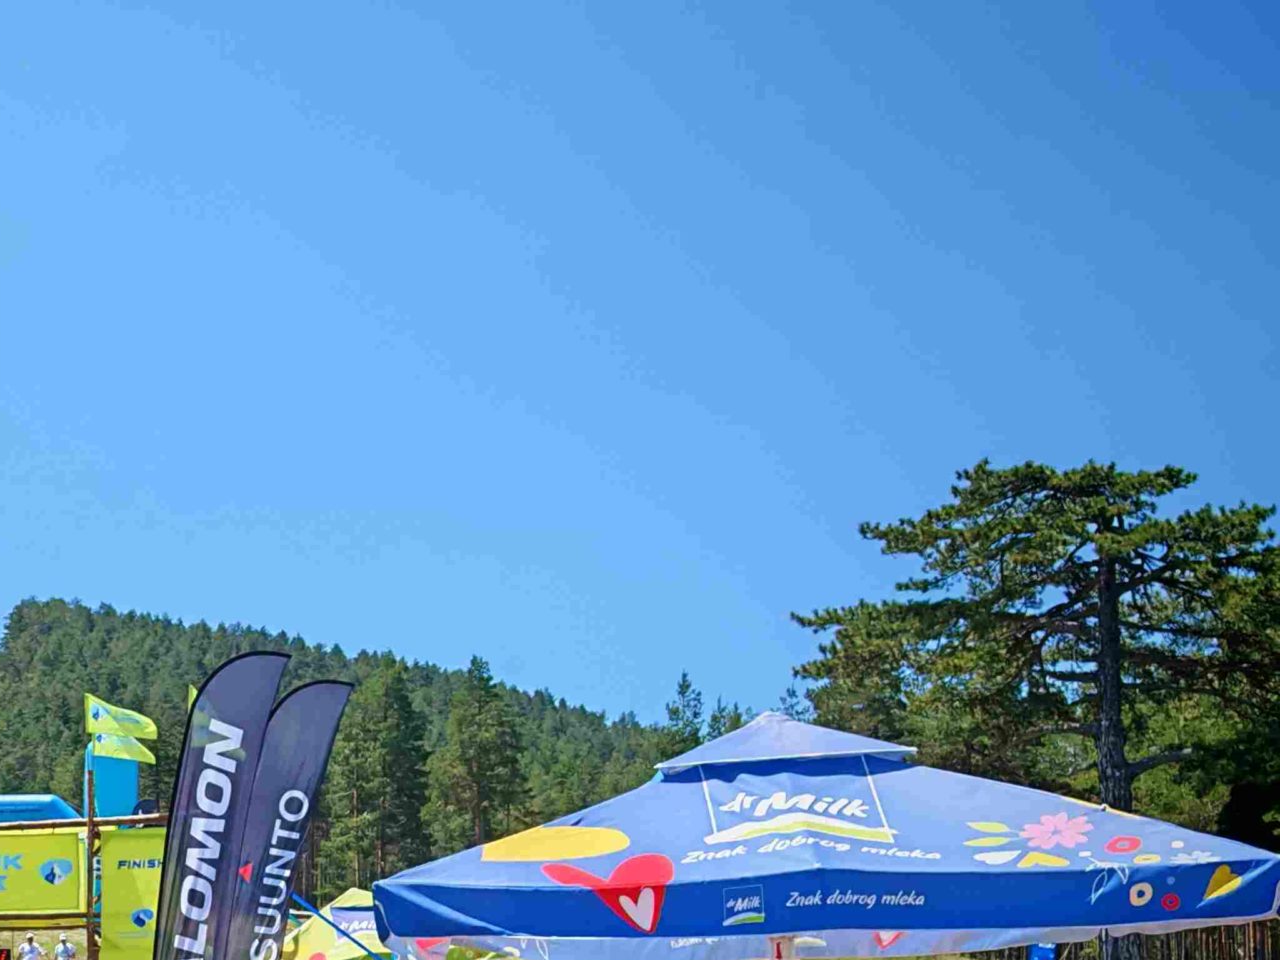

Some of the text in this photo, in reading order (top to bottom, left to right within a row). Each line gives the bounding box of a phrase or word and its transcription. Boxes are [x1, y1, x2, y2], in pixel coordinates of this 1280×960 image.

[753, 791, 869, 818] Milk
[681, 834, 941, 864] Znak dobrog mleka
[734, 895, 761, 913] Milk
[785, 890, 925, 910] Znak dobrog mleka
